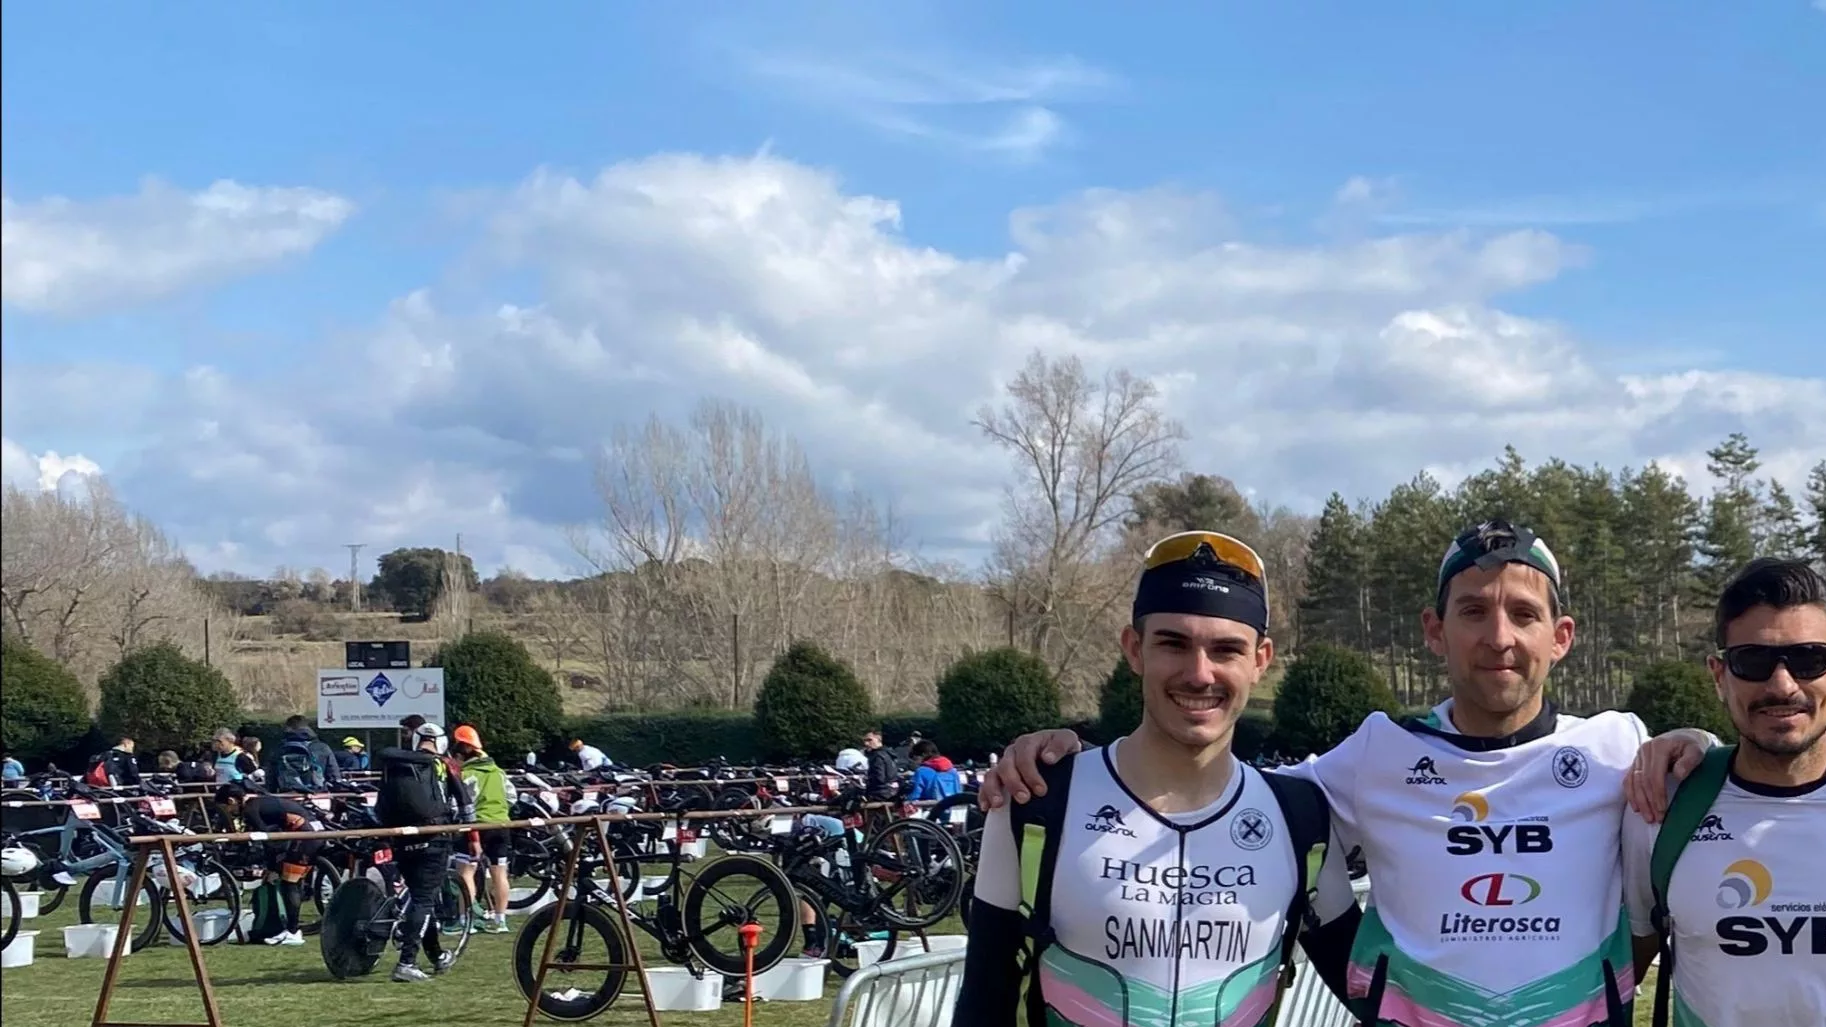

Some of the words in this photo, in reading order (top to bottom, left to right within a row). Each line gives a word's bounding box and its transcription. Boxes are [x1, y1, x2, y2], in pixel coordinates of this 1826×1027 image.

[1446, 824, 1554, 856] SYB
[1099, 856, 1258, 890] Huesca
[1120, 884, 1150, 903] La
[1770, 903, 1812, 914] servicios
[1440, 912, 1561, 935] Literosca
[1104, 915, 1252, 964] SANMARTIN
